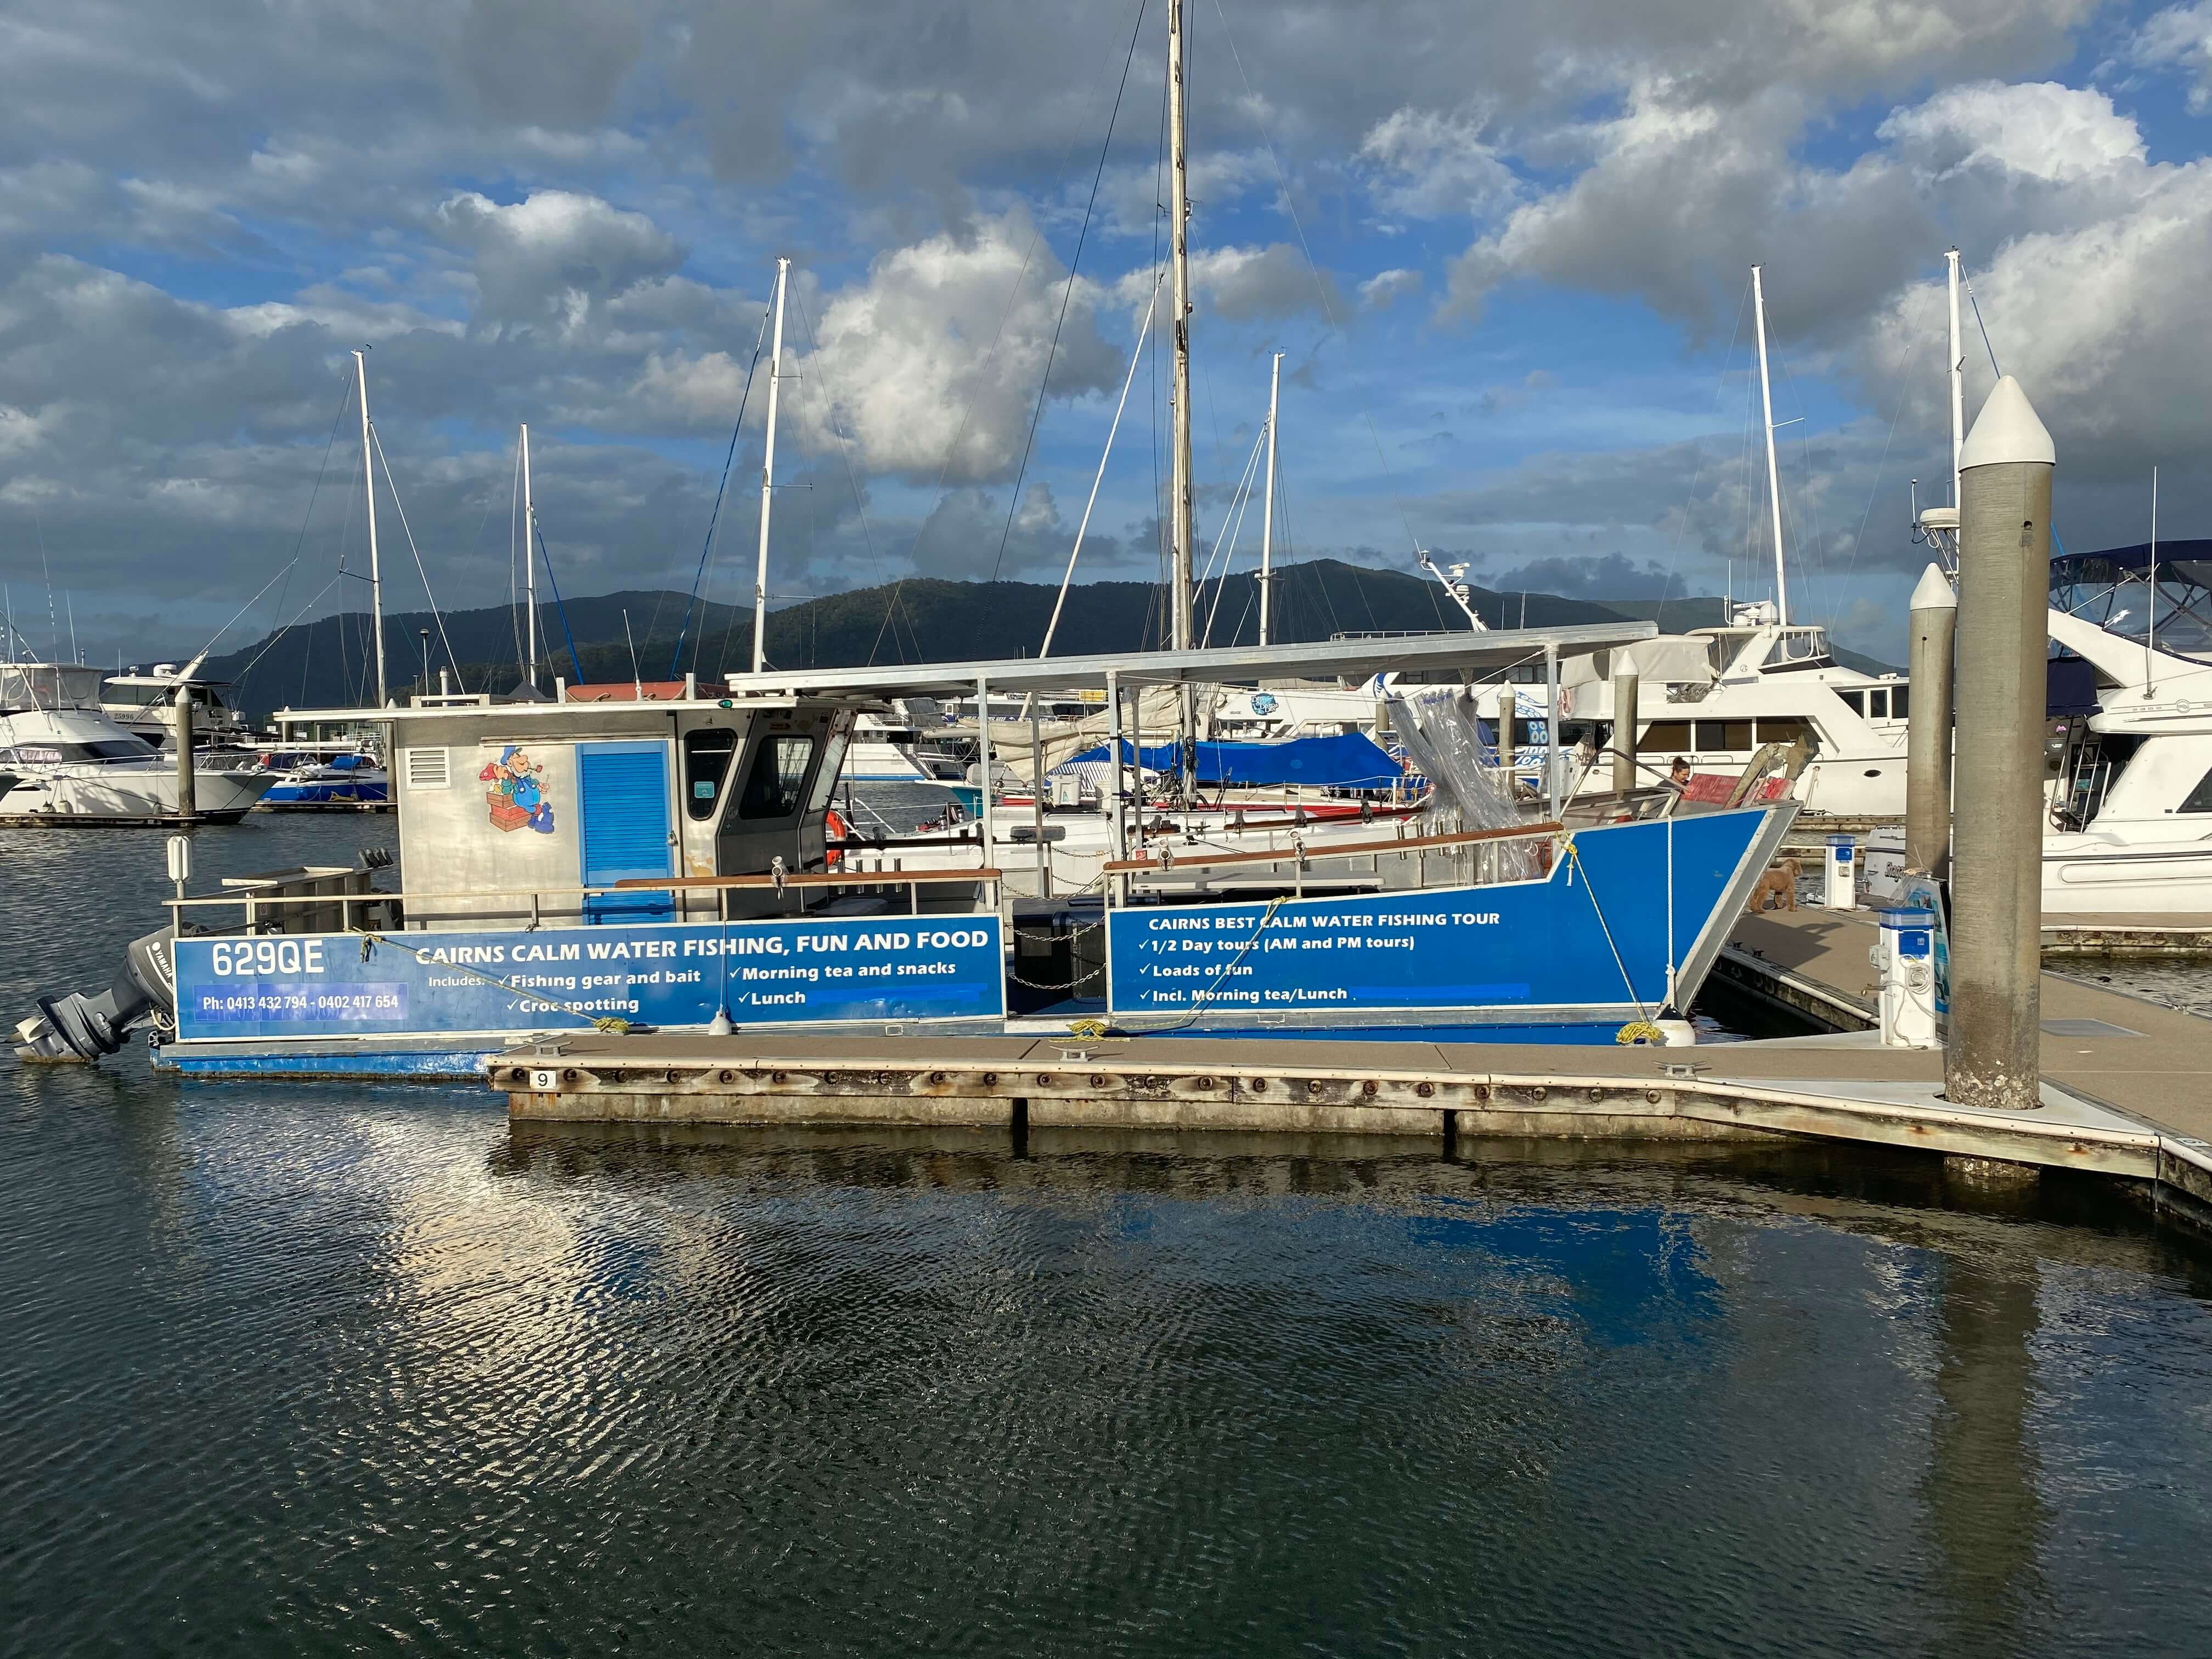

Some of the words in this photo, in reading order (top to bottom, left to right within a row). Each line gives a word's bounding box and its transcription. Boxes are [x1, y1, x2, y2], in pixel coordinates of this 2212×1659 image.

[1149, 918, 1210, 930] CAIRNS
[1215, 917, 1255, 929] BEST
[1312, 915, 1373, 927] WATER
[1378, 913, 1447, 926] FISHING
[1452, 913, 1500, 925] TOUR
[415, 945, 505, 964] CAIRNS
[511, 944, 580, 961] CALM
[587, 941, 677, 960] WATER
[684, 936, 790, 956] FISHING,
[797, 935, 848, 952] FUN
[854, 933, 910, 951] AND
[917, 930, 988, 949] FOOD
[1152, 940, 1177, 955] 1/2
[1182, 940, 1212, 953] Day
[1217, 940, 1259, 951] tours
[1265, 938, 1297, 952] (AM
[1302, 938, 1332, 949] and
[1338, 936, 1361, 948] PM
[1367, 936, 1414, 950] tours)
[155, 950, 173, 978] YAMAHA
[212, 940, 324, 975] 629QE
[742, 966, 819, 981] Morning
[825, 967, 853, 978] tea
[858, 963, 891, 976] and
[897, 962, 956, 975] snacks
[1153, 965, 1200, 977] Loads
[1205, 964, 1221, 975] of
[1226, 964, 1252, 975] fun
[511, 975, 576, 990] Fishing
[582, 974, 621, 990] gear
[627, 971, 659, 984] and
[665, 970, 701, 983] bait
[203, 996, 224, 1009] Ph:
[227, 996, 255, 1009] 0413
[258, 996, 282, 1009] 432
[285, 996, 308, 1008] 794
[319, 995, 350, 1008] 0402
[353, 995, 372, 1008] 417
[375, 995, 398, 1008] 654
[751, 991, 805, 1005] Lunch
[1153, 990, 1187, 1001] Incl.
[1192, 989, 1259, 1003] Morning
[1265, 988, 1347, 1002] tea/Lunch
[520, 1000, 558, 1013] Croc
[564, 997, 639, 1014] spotting
[538, 1073, 548, 1086] 9
